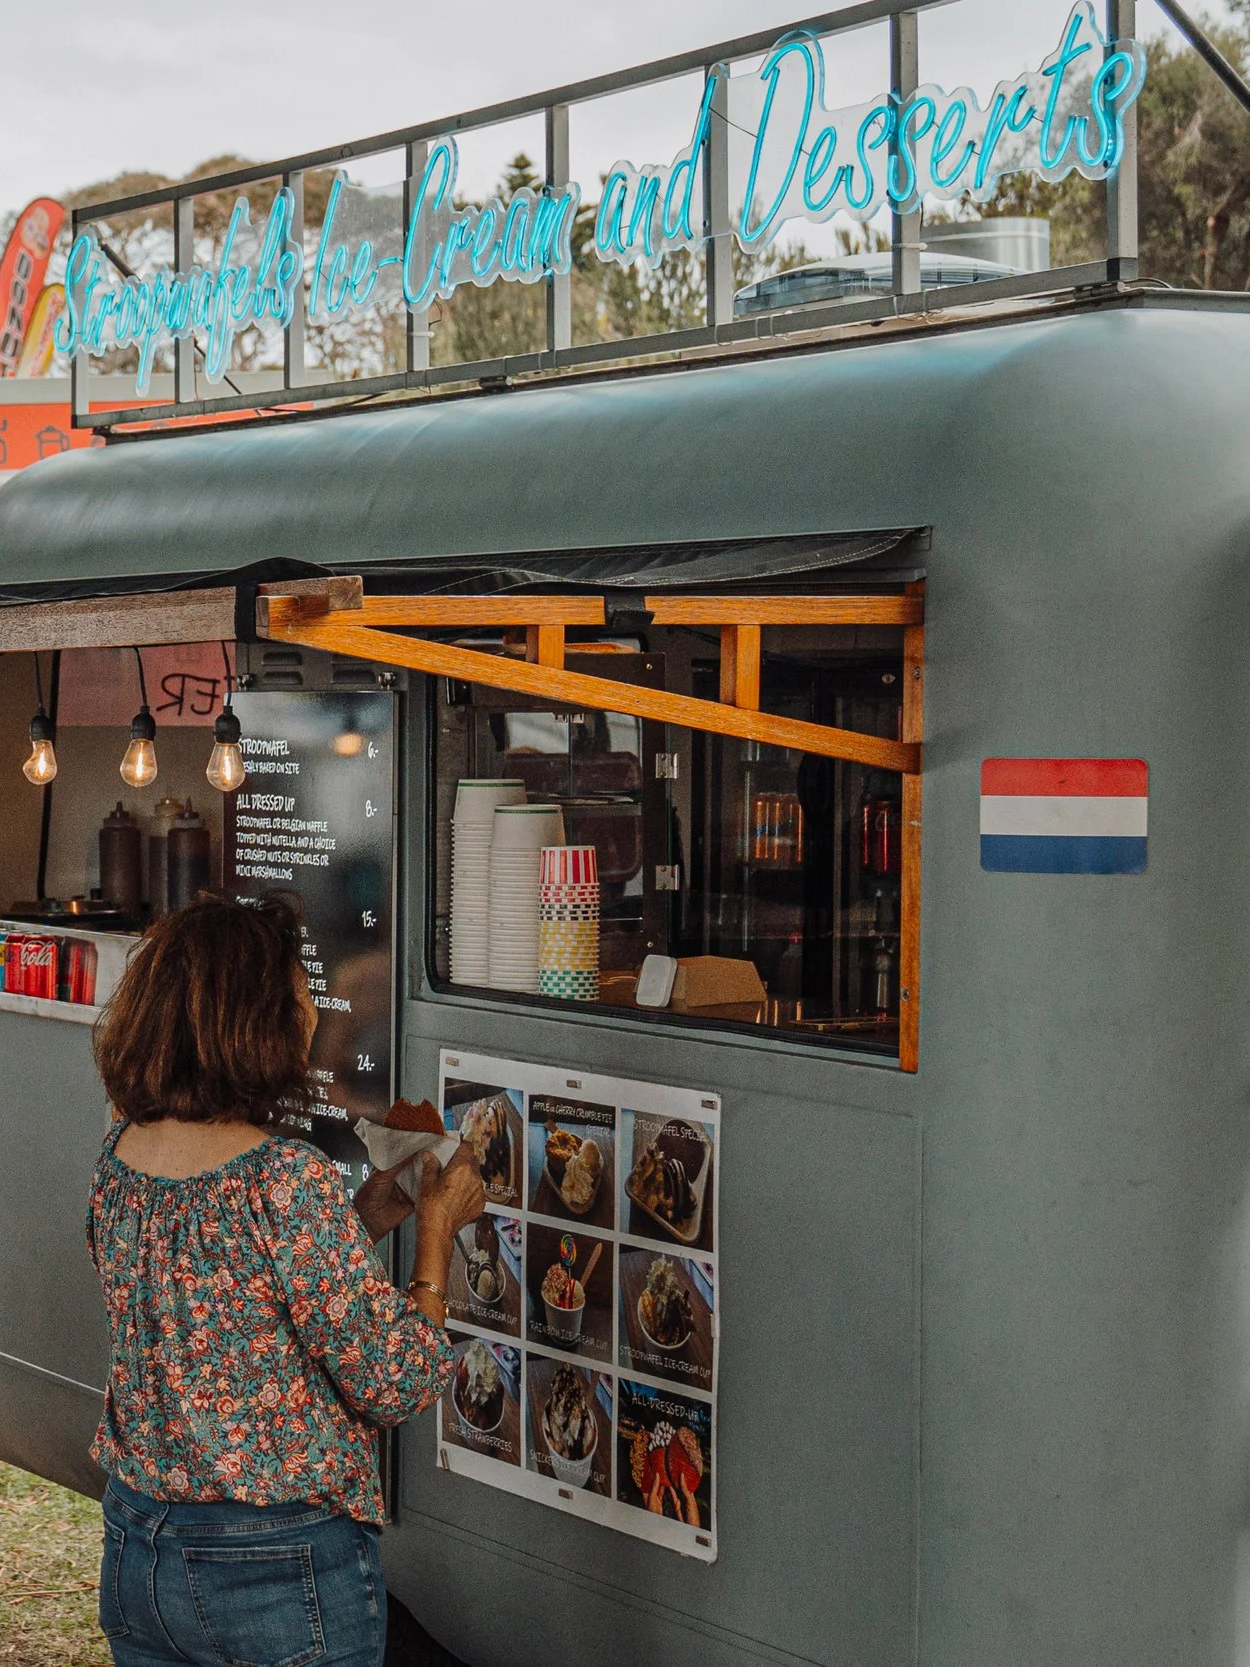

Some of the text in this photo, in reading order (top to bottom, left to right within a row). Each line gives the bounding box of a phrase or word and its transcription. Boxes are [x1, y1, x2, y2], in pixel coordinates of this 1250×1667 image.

[597, 75, 717, 257] and
[741, 14, 1133, 241] Desserts
[276, 763, 284, 773] ON
[285, 762, 300, 774] SITE
[237, 794, 251, 811] ALL
[251, 793, 284, 811] DRESSED
[285, 796, 295, 812] UP
[236, 815, 328, 833] STROOPWAFEL OR BELGIAN WAFFLE
[236, 832, 336, 850] TOPPED WITH NUTELLA AND A CHOICE
[236, 848, 329, 866] OF CRUSHED NUTS OR SPRINKLES OR
[252, 865, 293, 880] MARSHMALLOWS
[315, 979, 327, 992] PIE
[533, 1101, 550, 1112] APPLE
[556, 1104, 576, 1116] CHERRY
[576, 1107, 602, 1121] CRUMBLE
[602, 1113, 613, 1123] PIE
[664, 1357, 699, 1375] ICE-CREAM
[699, 1366, 711, 1378] CUP
[467, 1428, 512, 1452] STRAWBERRIES
